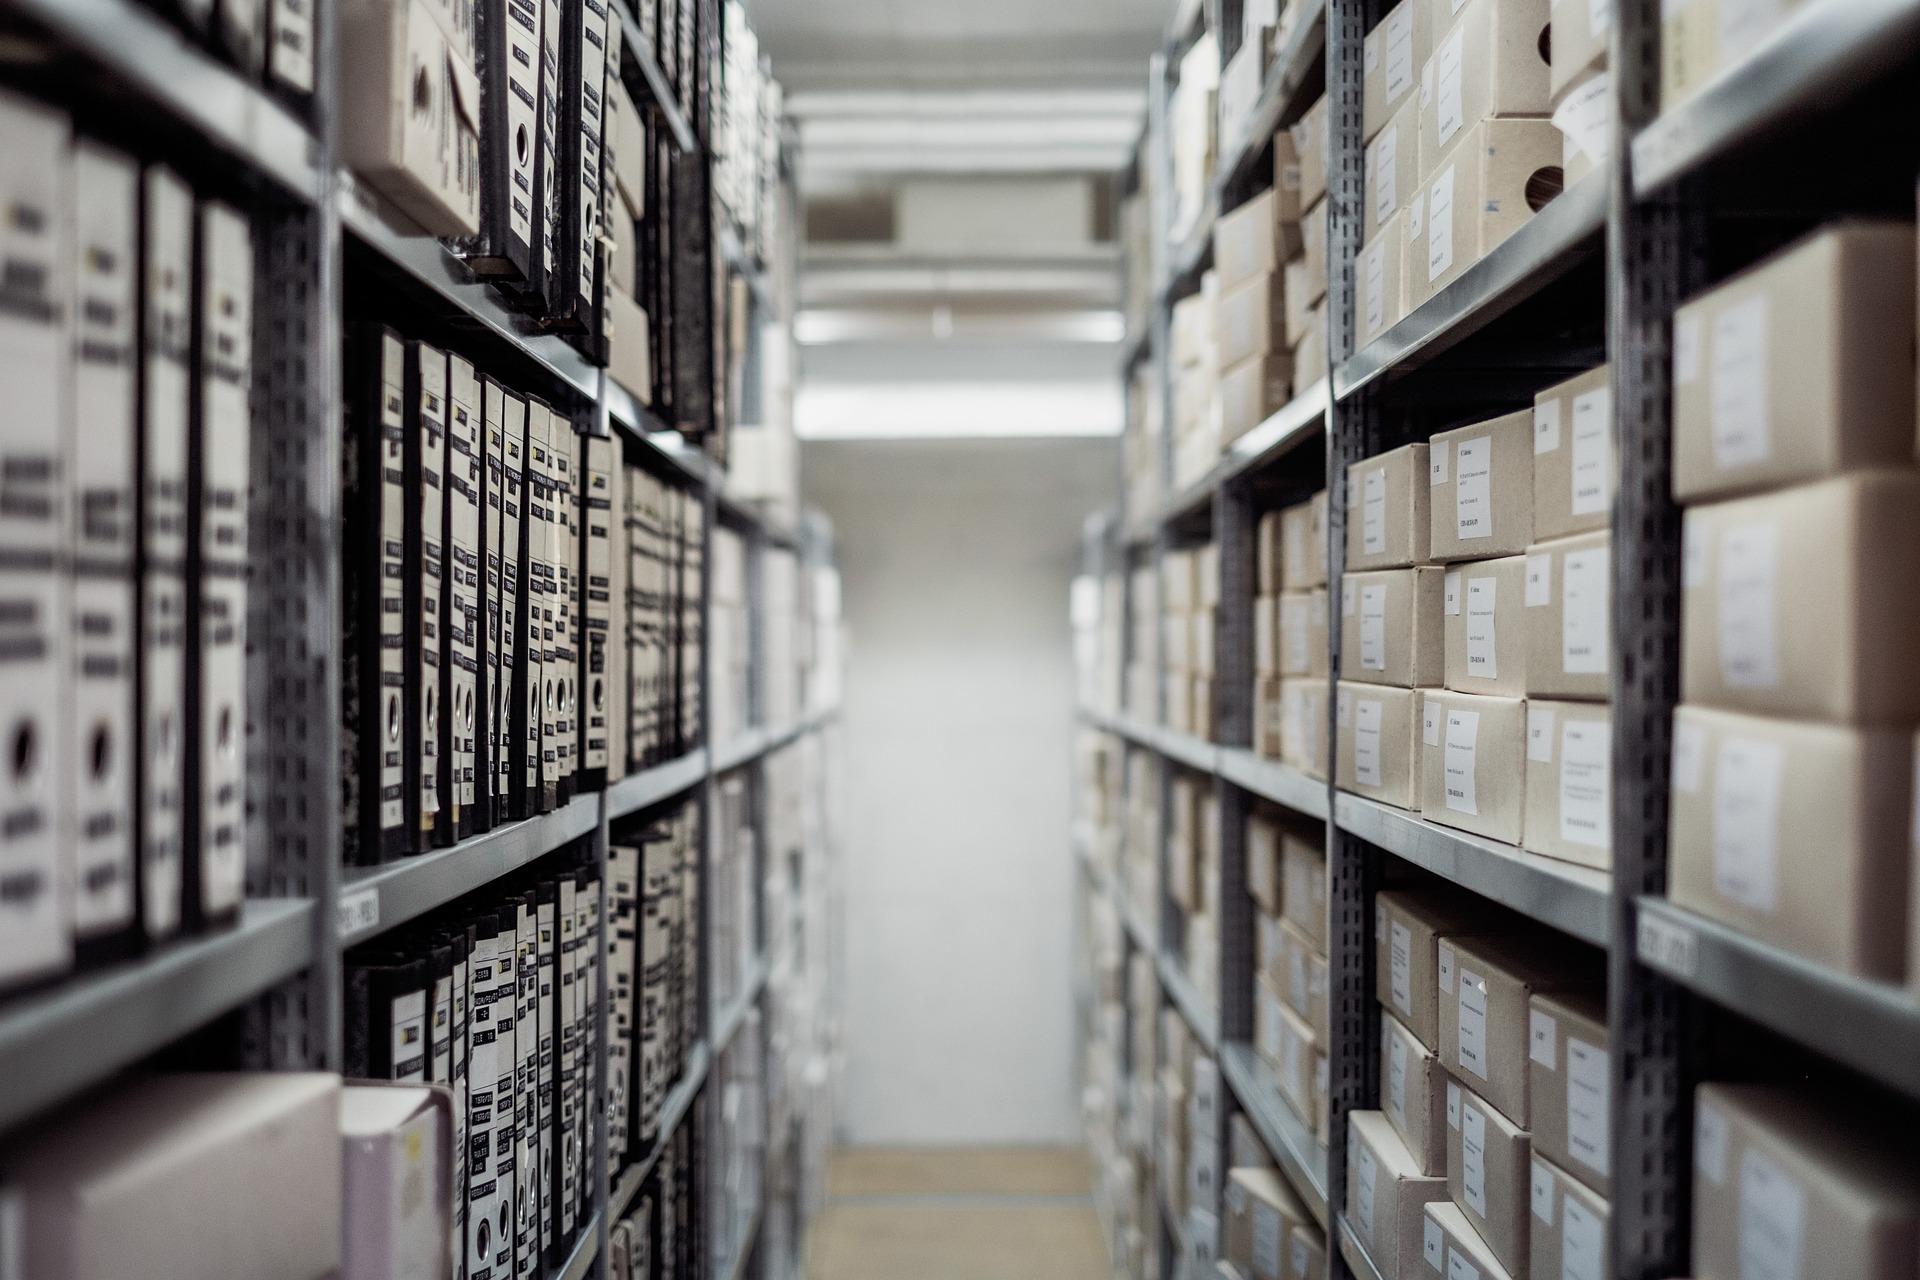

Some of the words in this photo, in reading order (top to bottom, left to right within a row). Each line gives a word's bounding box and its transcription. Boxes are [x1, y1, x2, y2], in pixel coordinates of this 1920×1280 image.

[516, 49, 529, 65] CERN
[473, 1135, 486, 1145] STAFF
[473, 1148, 487, 1158] RULES
[474, 1163, 483, 1172] AND
